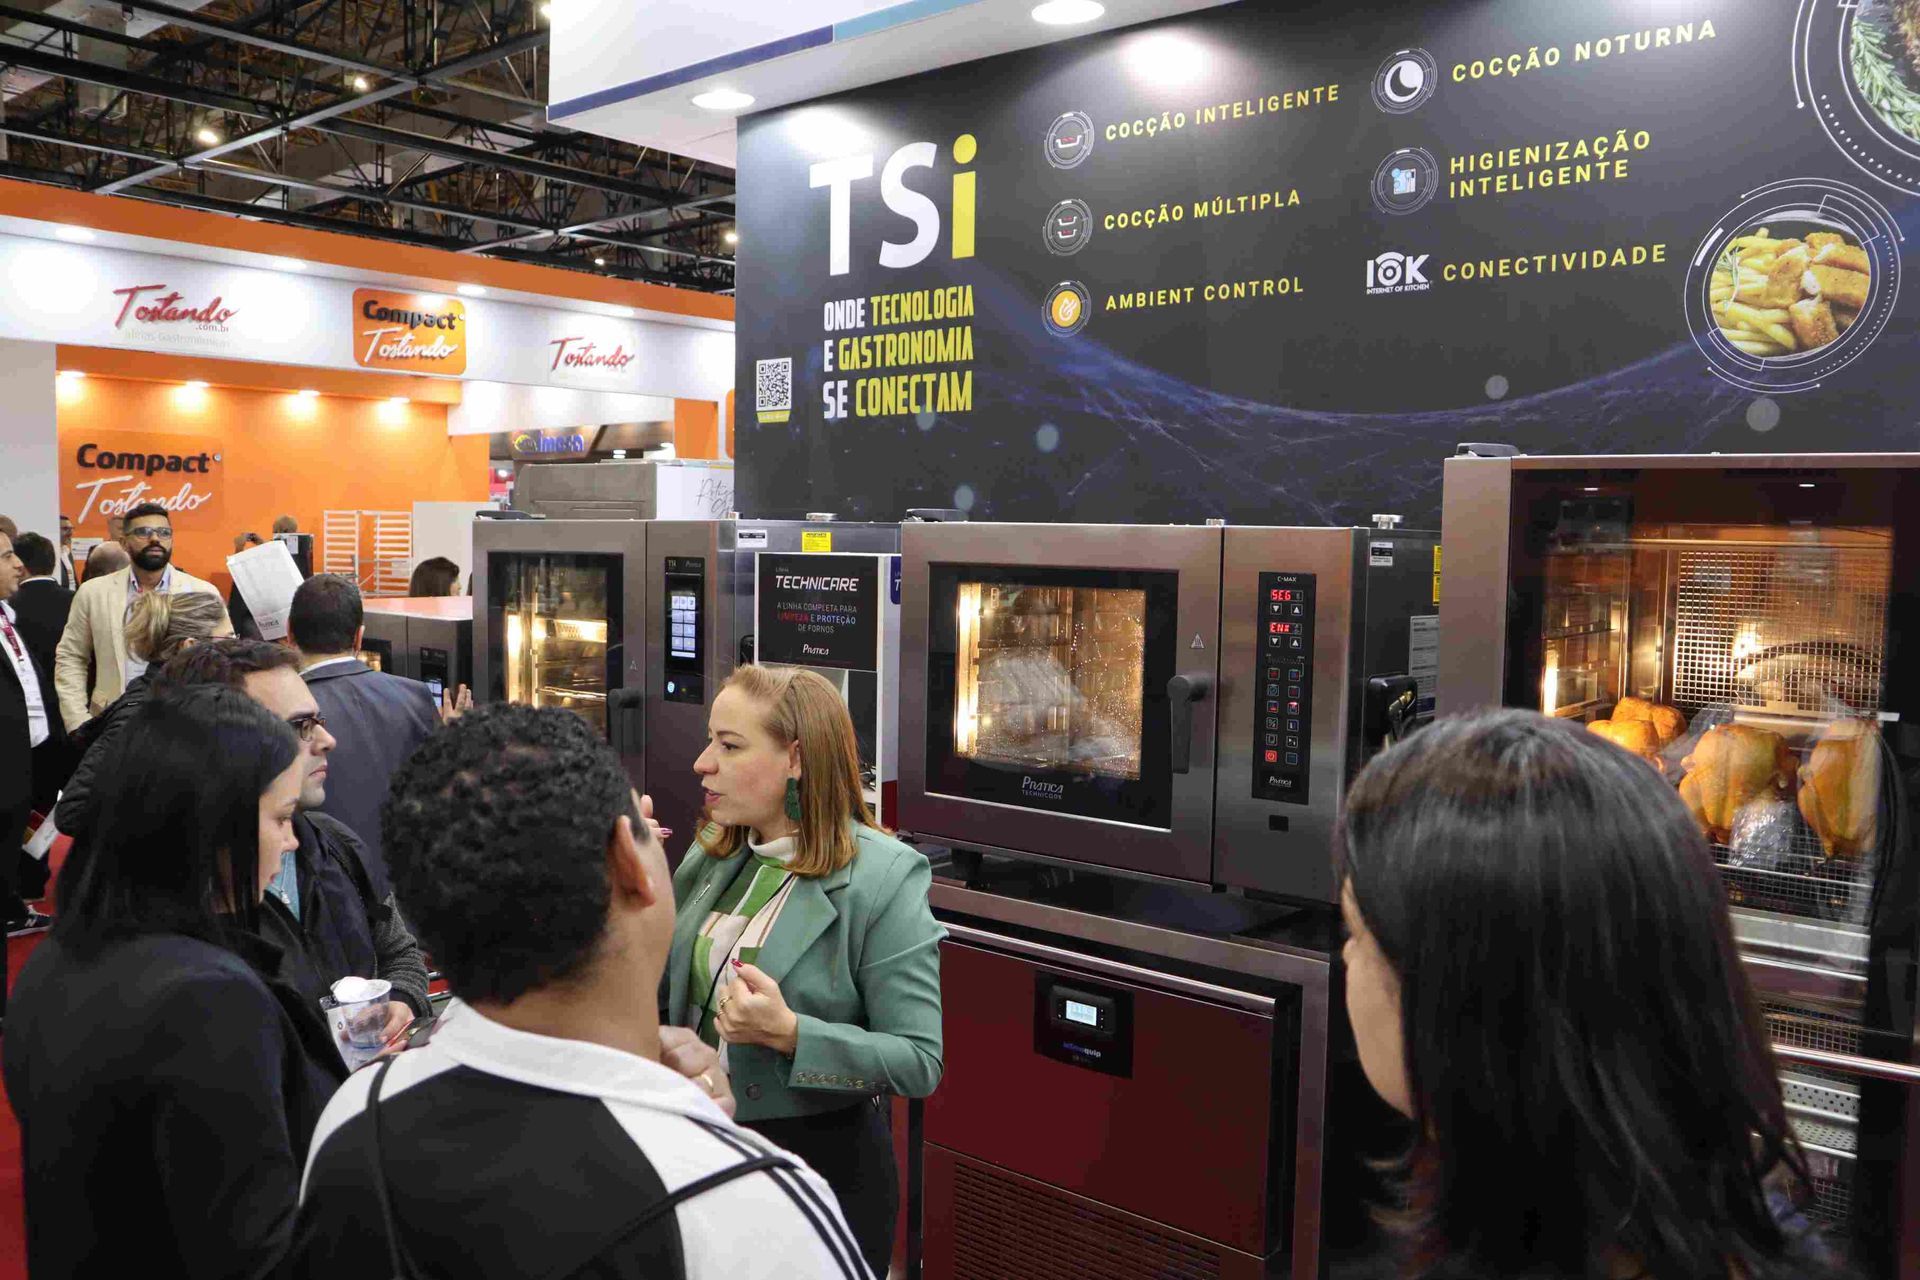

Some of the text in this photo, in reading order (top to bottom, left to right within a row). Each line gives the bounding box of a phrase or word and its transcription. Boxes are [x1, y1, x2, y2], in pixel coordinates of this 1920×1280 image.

[1452, 19, 1717, 82] COCÇÃO NOTURNA
[1105, 84, 1340, 141] COCÇÃO INTELIGENTE
[1450, 128, 1650, 175] HIGIENIZAÇÃO
[1450, 159, 1629, 198] INTELIGENTE
[809, 133, 977, 276] TSi
[1104, 189, 1300, 230] COCÇÃO MÚLTIPLA
[1366, 251, 1430, 287] IOK
[1443, 244, 1667, 281] CONECTIVIDADE
[112, 284, 240, 330] Tostando
[1105, 276, 1304, 311] AMBIENT CONTROL
[1366, 286, 1394, 295] INTERNET
[1404, 283, 1430, 292] KITCHEN
[363, 299, 456, 330] Compact
[823, 285, 974, 332] ONDE TECNOLOGIA
[363, 326, 458, 362] Tostando
[548, 336, 636, 372] Tostando
[823, 325, 974, 373] E GASTRONOMIA
[822, 370, 973, 419] SE CONECTAM
[77, 443, 210, 476] Compact
[775, 575, 860, 592] TECHNICARE
[782, 602, 802, 610] LINHA
[803, 603, 838, 613] COMPLETA
[839, 604, 857, 613] PARA
[810, 614, 815, 622] E
[816, 614, 856, 627] PROTEÇÃO
[797, 624, 834, 634] DE FORNOS
